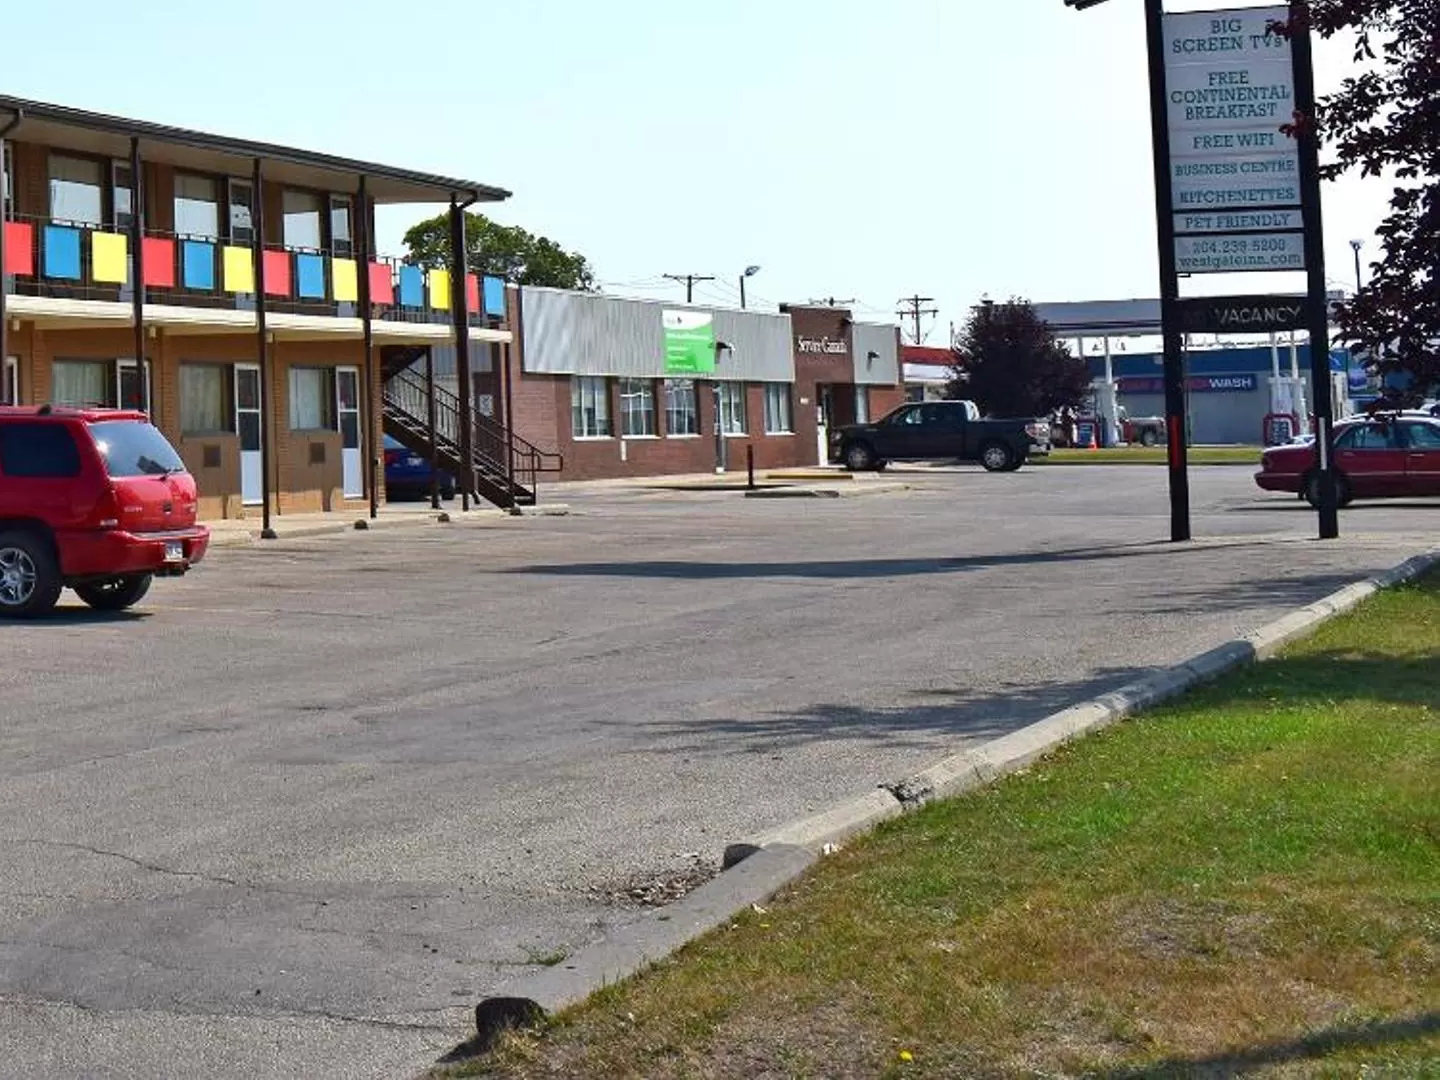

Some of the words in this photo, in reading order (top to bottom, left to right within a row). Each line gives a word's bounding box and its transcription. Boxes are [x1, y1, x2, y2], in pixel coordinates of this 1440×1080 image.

[1211, 19, 1242, 34] BIG
[1172, 35, 1244, 54] SCREEN
[1208, 70, 1249, 86] FREE
[1170, 86, 1291, 104] CONTINENTAL
[1185, 102, 1277, 120] BREAKFAST
[1192, 134, 1233, 150] FREE
[1237, 132, 1275, 147] WIFI
[1175, 163, 1238, 177] BUSINESS
[1240, 159, 1295, 174] CENTRE
[1180, 187, 1296, 204] KITCHENETTES
[1185, 216, 1212, 230] PET
[1216, 213, 1291, 228] FRIENDLY
[1180, 254, 1301, 269] westgateinn.com
[1213, 305, 1301, 324] VACANCY
[1209, 376, 1252, 388] WASH
